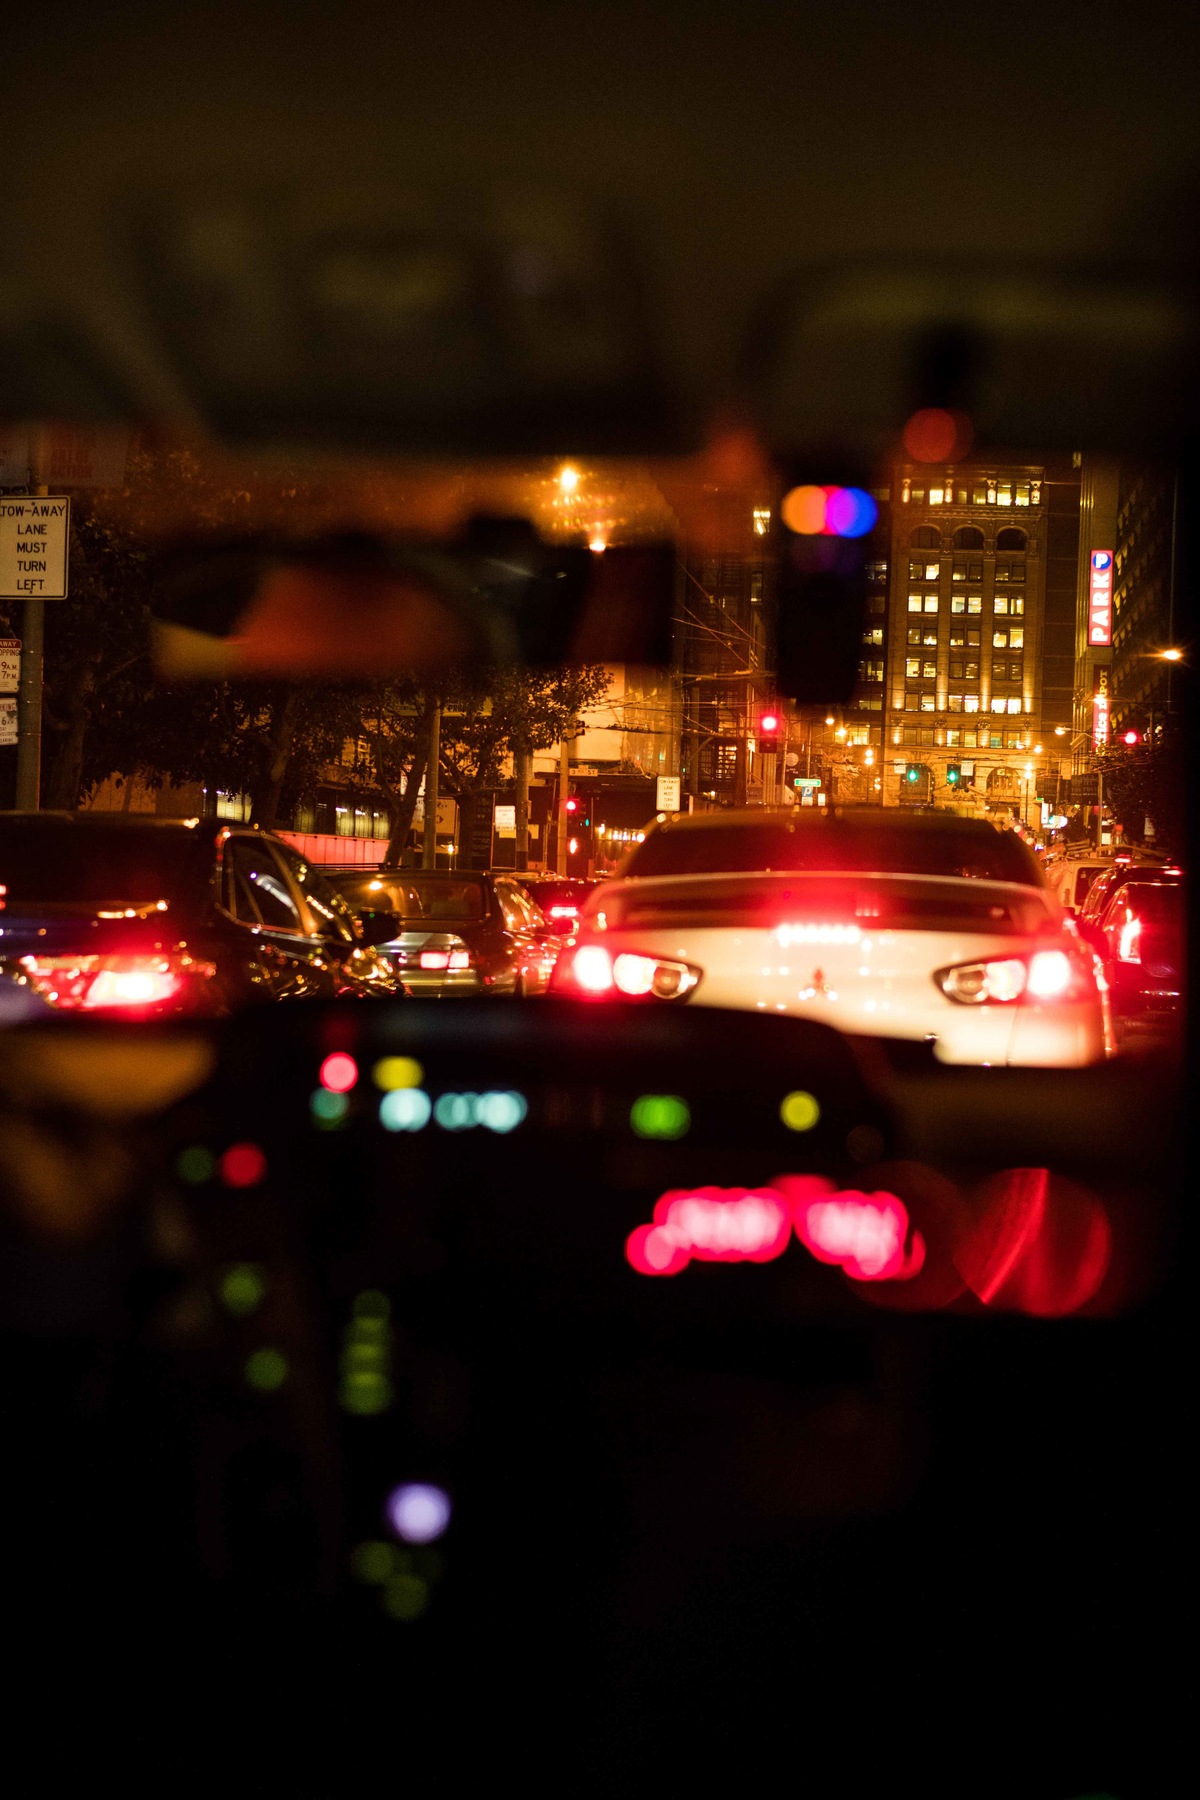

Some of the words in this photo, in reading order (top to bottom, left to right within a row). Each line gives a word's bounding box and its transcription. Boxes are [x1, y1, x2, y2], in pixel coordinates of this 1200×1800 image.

[1, 506, 65, 517] TOW-AWAY
[17, 524, 47, 535] LANE
[16, 542, 47, 553] MUST
[17, 561, 46, 571] TURN
[17, 579, 44, 590] LEFT
[1091, 572, 1109, 642] PARK
